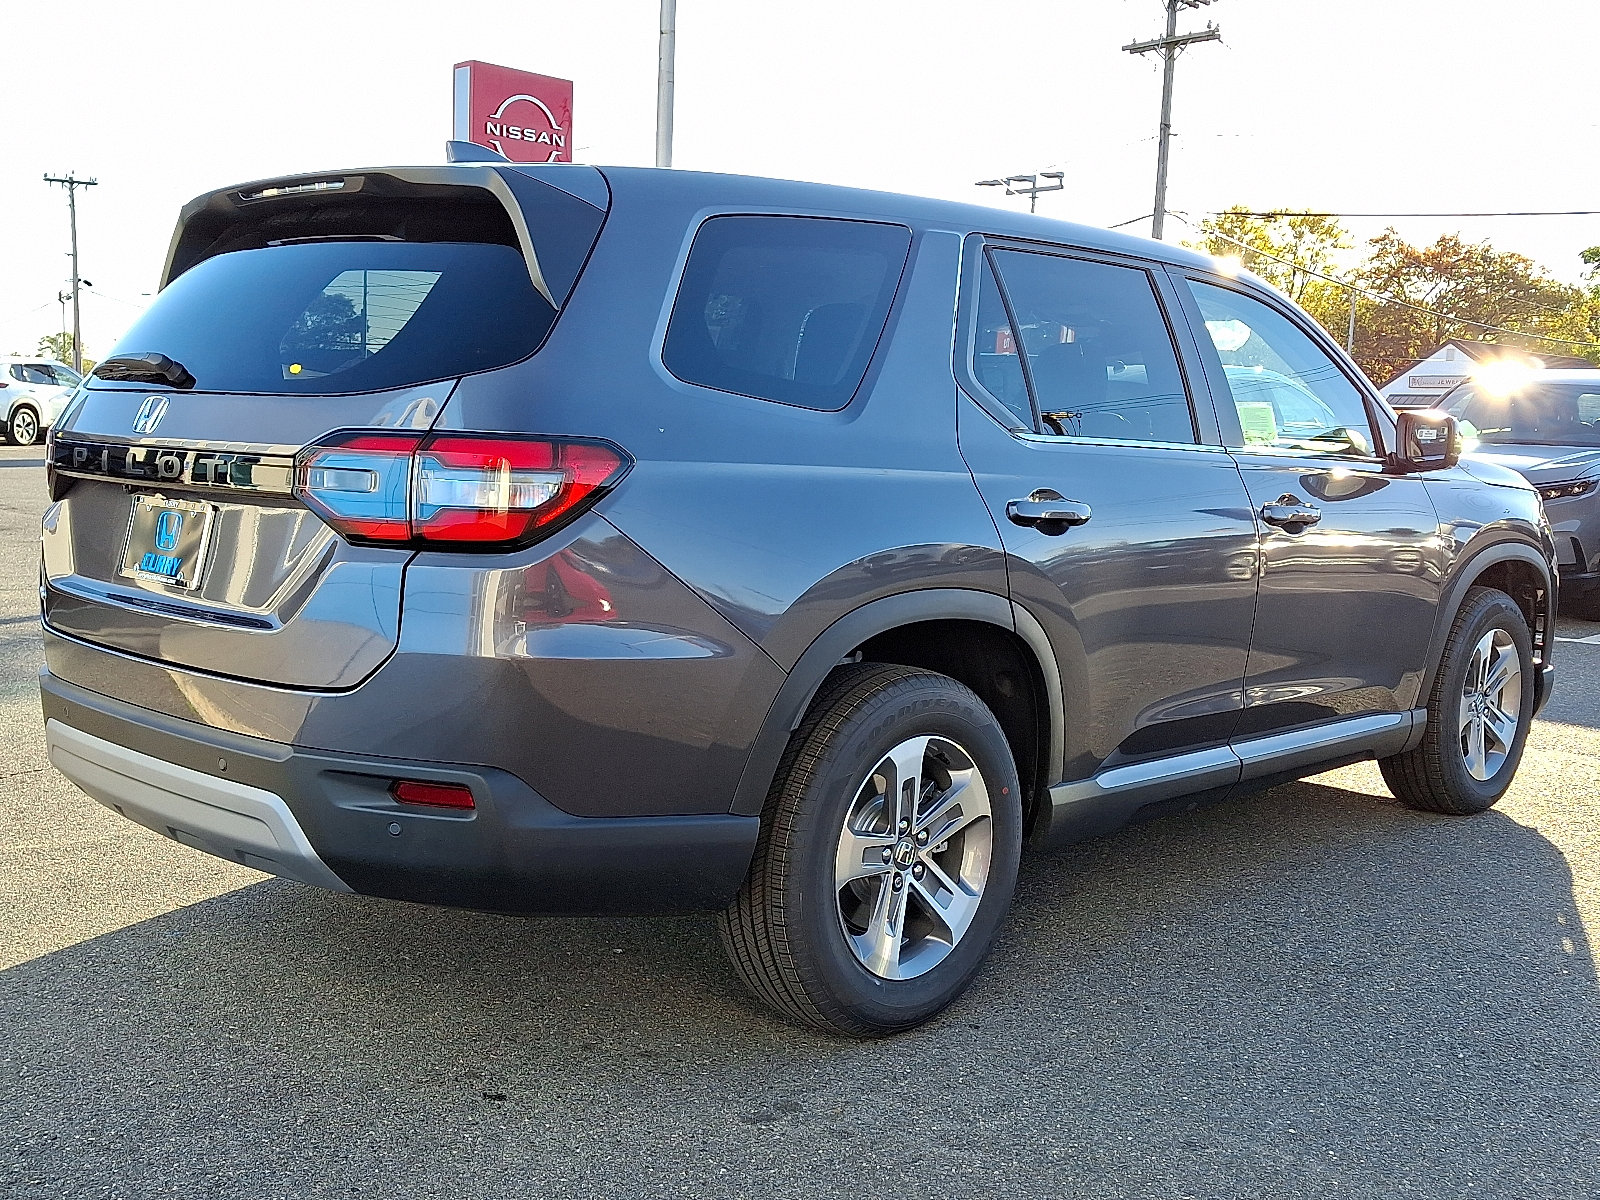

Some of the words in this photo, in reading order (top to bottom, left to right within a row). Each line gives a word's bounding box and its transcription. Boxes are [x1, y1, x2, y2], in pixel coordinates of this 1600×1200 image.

[485, 121, 565, 147] NISSAN
[73, 446, 225, 482] PILOT
[141, 552, 182, 577] CURRY
